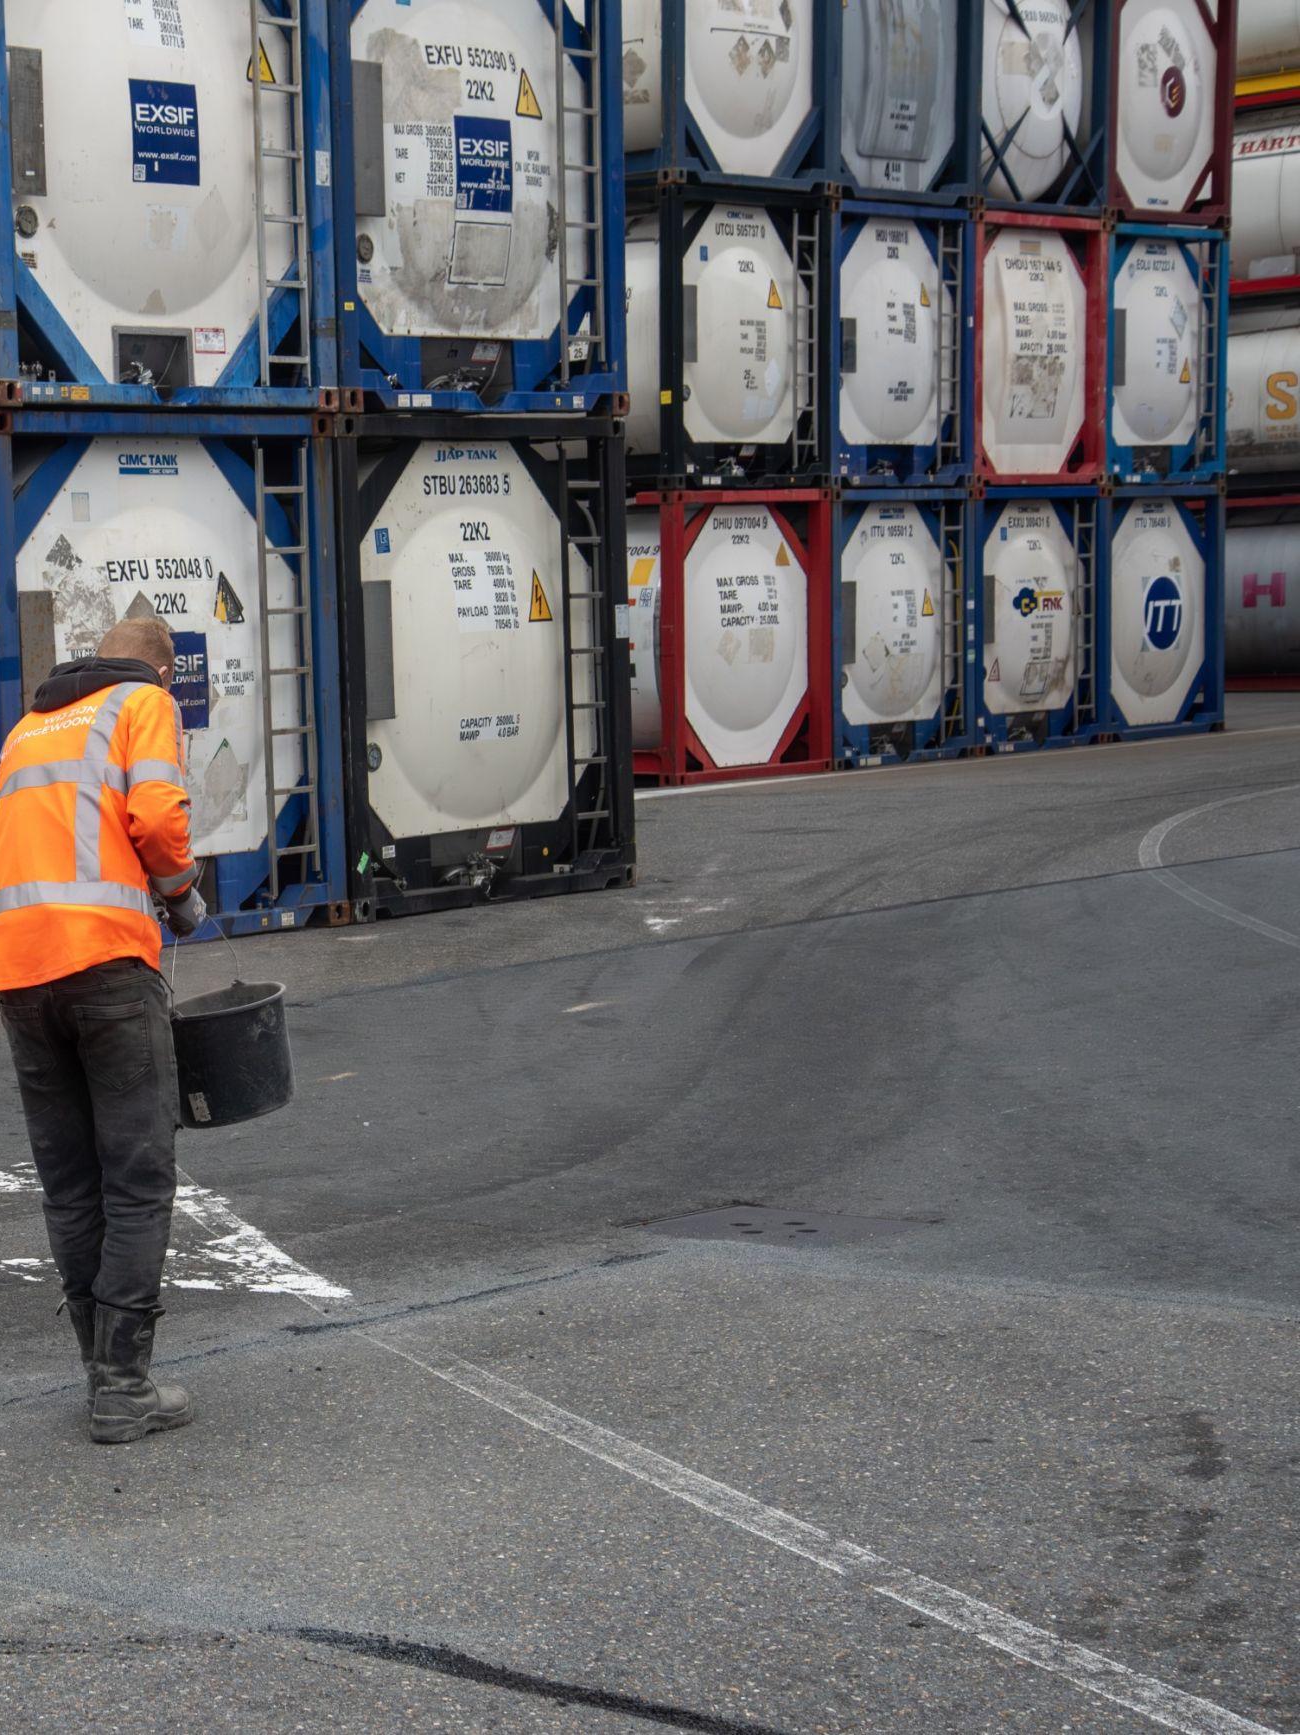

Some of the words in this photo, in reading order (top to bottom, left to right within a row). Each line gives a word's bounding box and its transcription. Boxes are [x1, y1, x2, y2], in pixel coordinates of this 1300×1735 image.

[128, 17, 145, 30] TARE
[425, 45, 462, 66] EXFU
[467, 47, 507, 71] 552390
[509, 54, 516, 73] 9
[466, 80, 496, 101] 22K2
[136, 103, 194, 125] EXSIF
[137, 125, 196, 138] WORLDWIDE
[394, 125, 405, 135] MAX
[406, 125, 423, 136] GROSS
[395, 149, 409, 159] TARE
[459, 138, 510, 158] EXSIF
[138, 151, 197, 162] www.exsif.com
[460, 157, 511, 169] WORLDWIDE
[715, 222, 734, 236] UTCU
[118, 454, 146, 466] CIMC
[148, 454, 178, 466] TANK
[468, 448, 497, 460] TANK
[423, 474, 455, 496] STBU
[459, 474, 499, 495] 263683
[503, 474, 510, 494] 5
[713, 517, 732, 530] DHIU
[734, 516, 760, 530] 097004
[460, 522, 490, 541] 22K2
[731, 533, 749, 545] 22K2
[448, 553, 467, 563] MAX.
[106, 560, 149, 582] EXFU
[156, 558, 202, 579] 552048
[452, 565, 476, 577] GROSS
[454, 579, 472, 590] TARE
[716, 577, 734, 588] MAX
[736, 575, 760, 586] GROSS
[718, 589, 738, 601] TARE
[1242, 572, 1286, 608] H
[154, 594, 188, 615] 22K2
[458, 605, 488, 618] PAYLOAD
[174, 654, 203, 672] SIF
[460, 716, 492, 729] CAPACITY
[460, 729, 480, 741] MAWP
